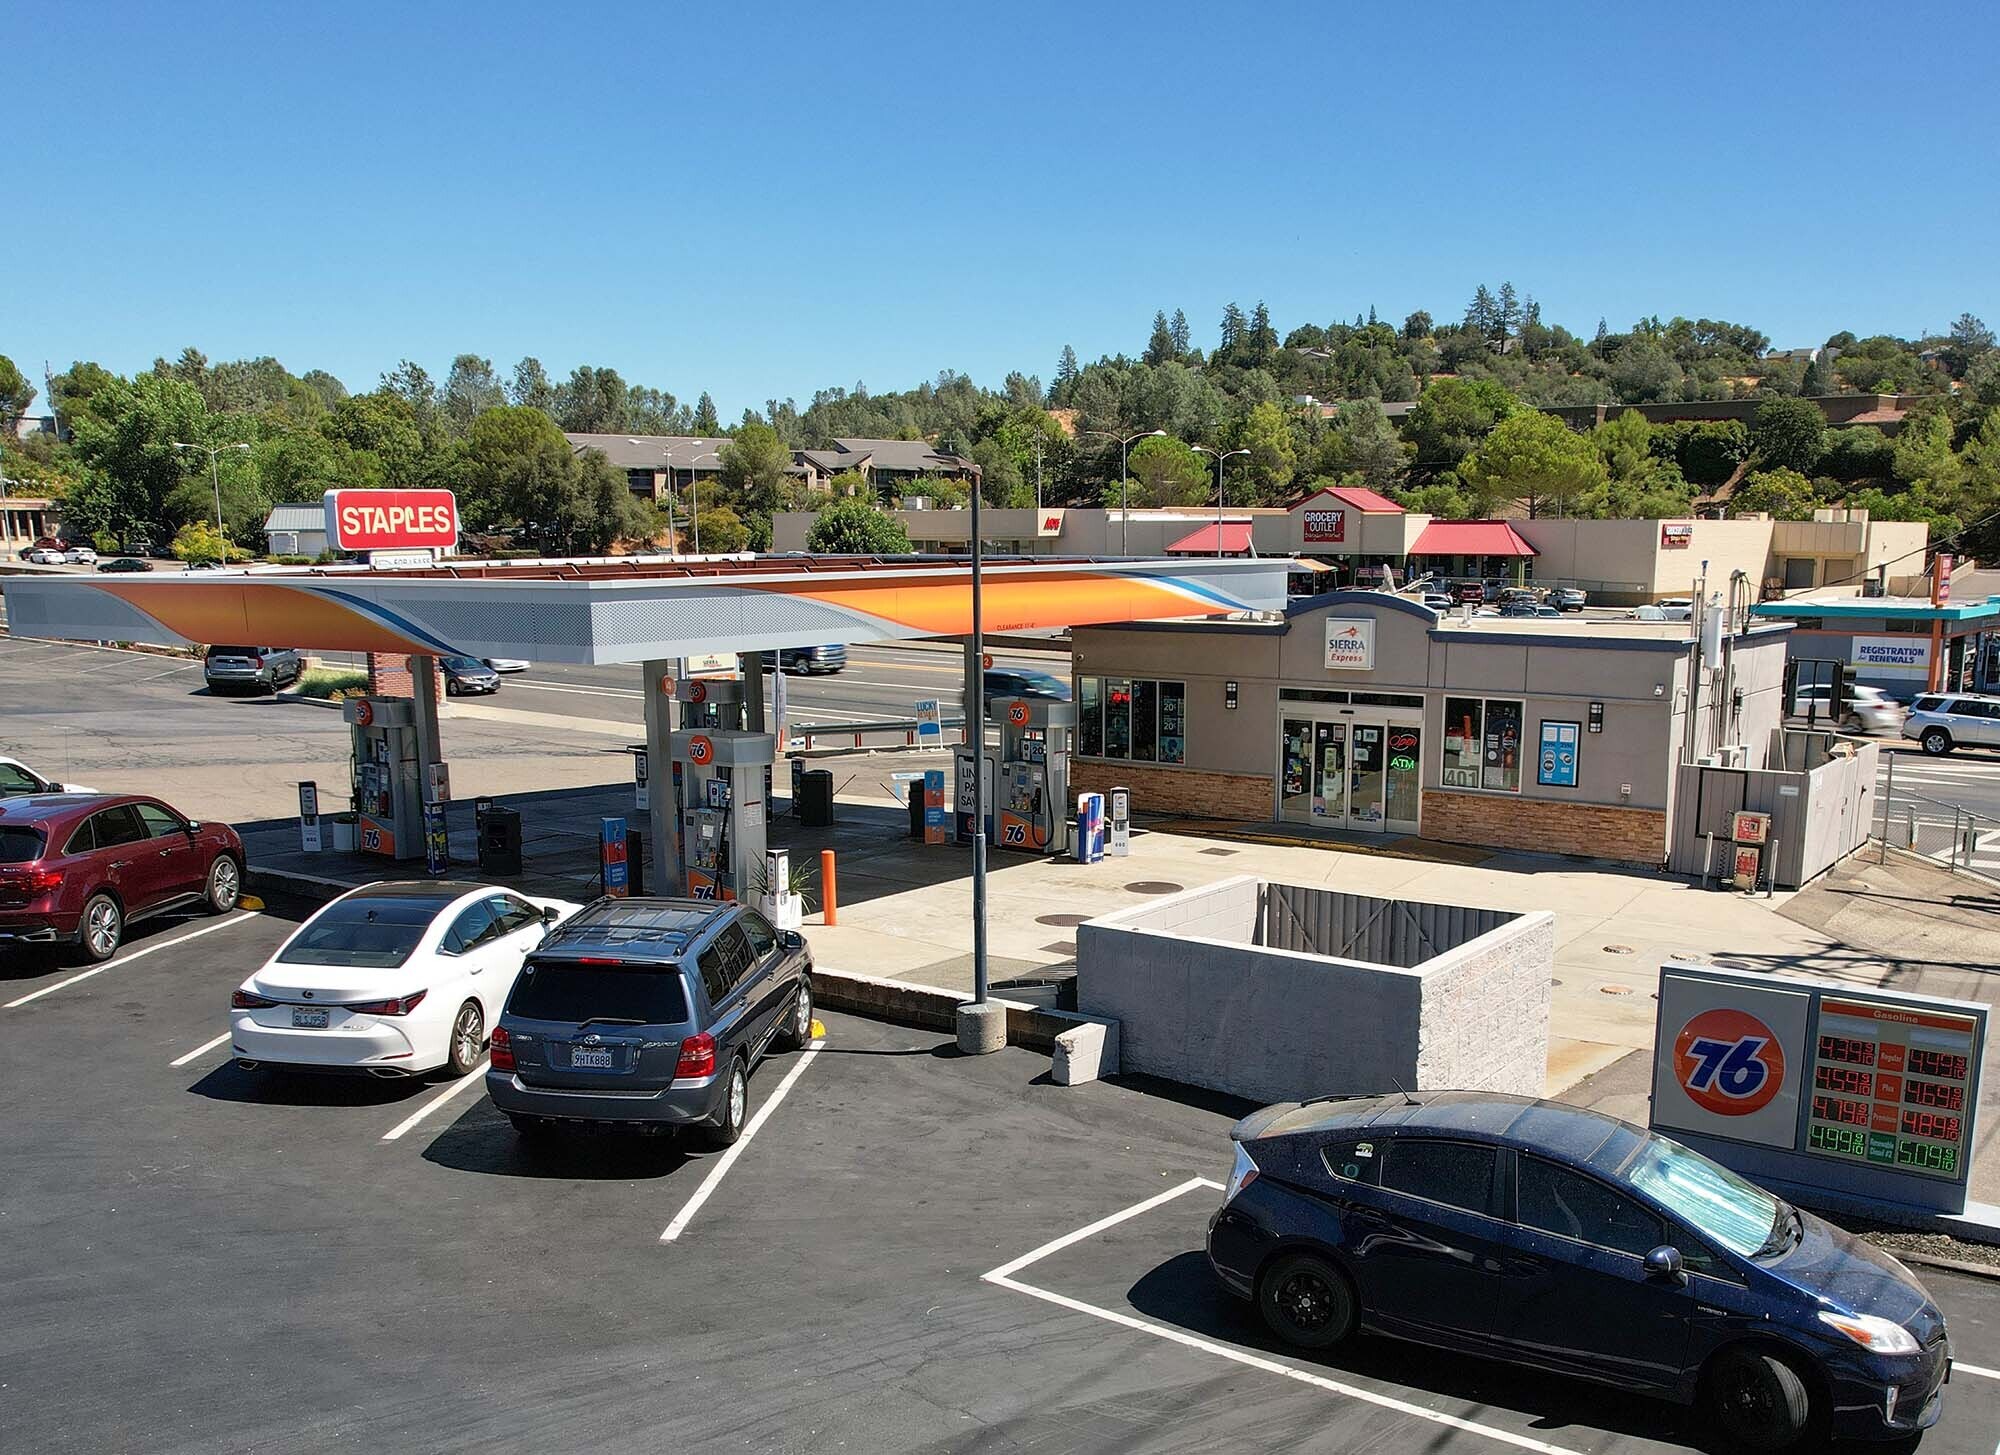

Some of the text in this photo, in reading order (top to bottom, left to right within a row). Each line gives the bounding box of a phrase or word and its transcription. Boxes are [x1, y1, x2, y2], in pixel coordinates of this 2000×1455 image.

[342, 506, 451, 535] STAPLES
[1304, 511, 1342, 522] GROCERY
[1310, 522, 1337, 532] OUTLET
[1328, 639, 1365, 650] SIERRA
[1331, 653, 1363, 663] Express
[1859, 646, 1925, 657] REGISTRATION
[1868, 655, 1915, 664] RENEWALS
[1009, 708, 1024, 722] 76
[690, 742, 706, 758] 76
[1390, 757, 1415, 769] ATM
[1445, 769, 1476, 787] 401
[363, 828, 380, 850] 76
[1005, 823, 1026, 844] 76
[1873, 1010, 1919, 1024] Gasoline
[574, 1054, 611, 1066] 9HTK888
[1685, 1035, 1770, 1099] 76
